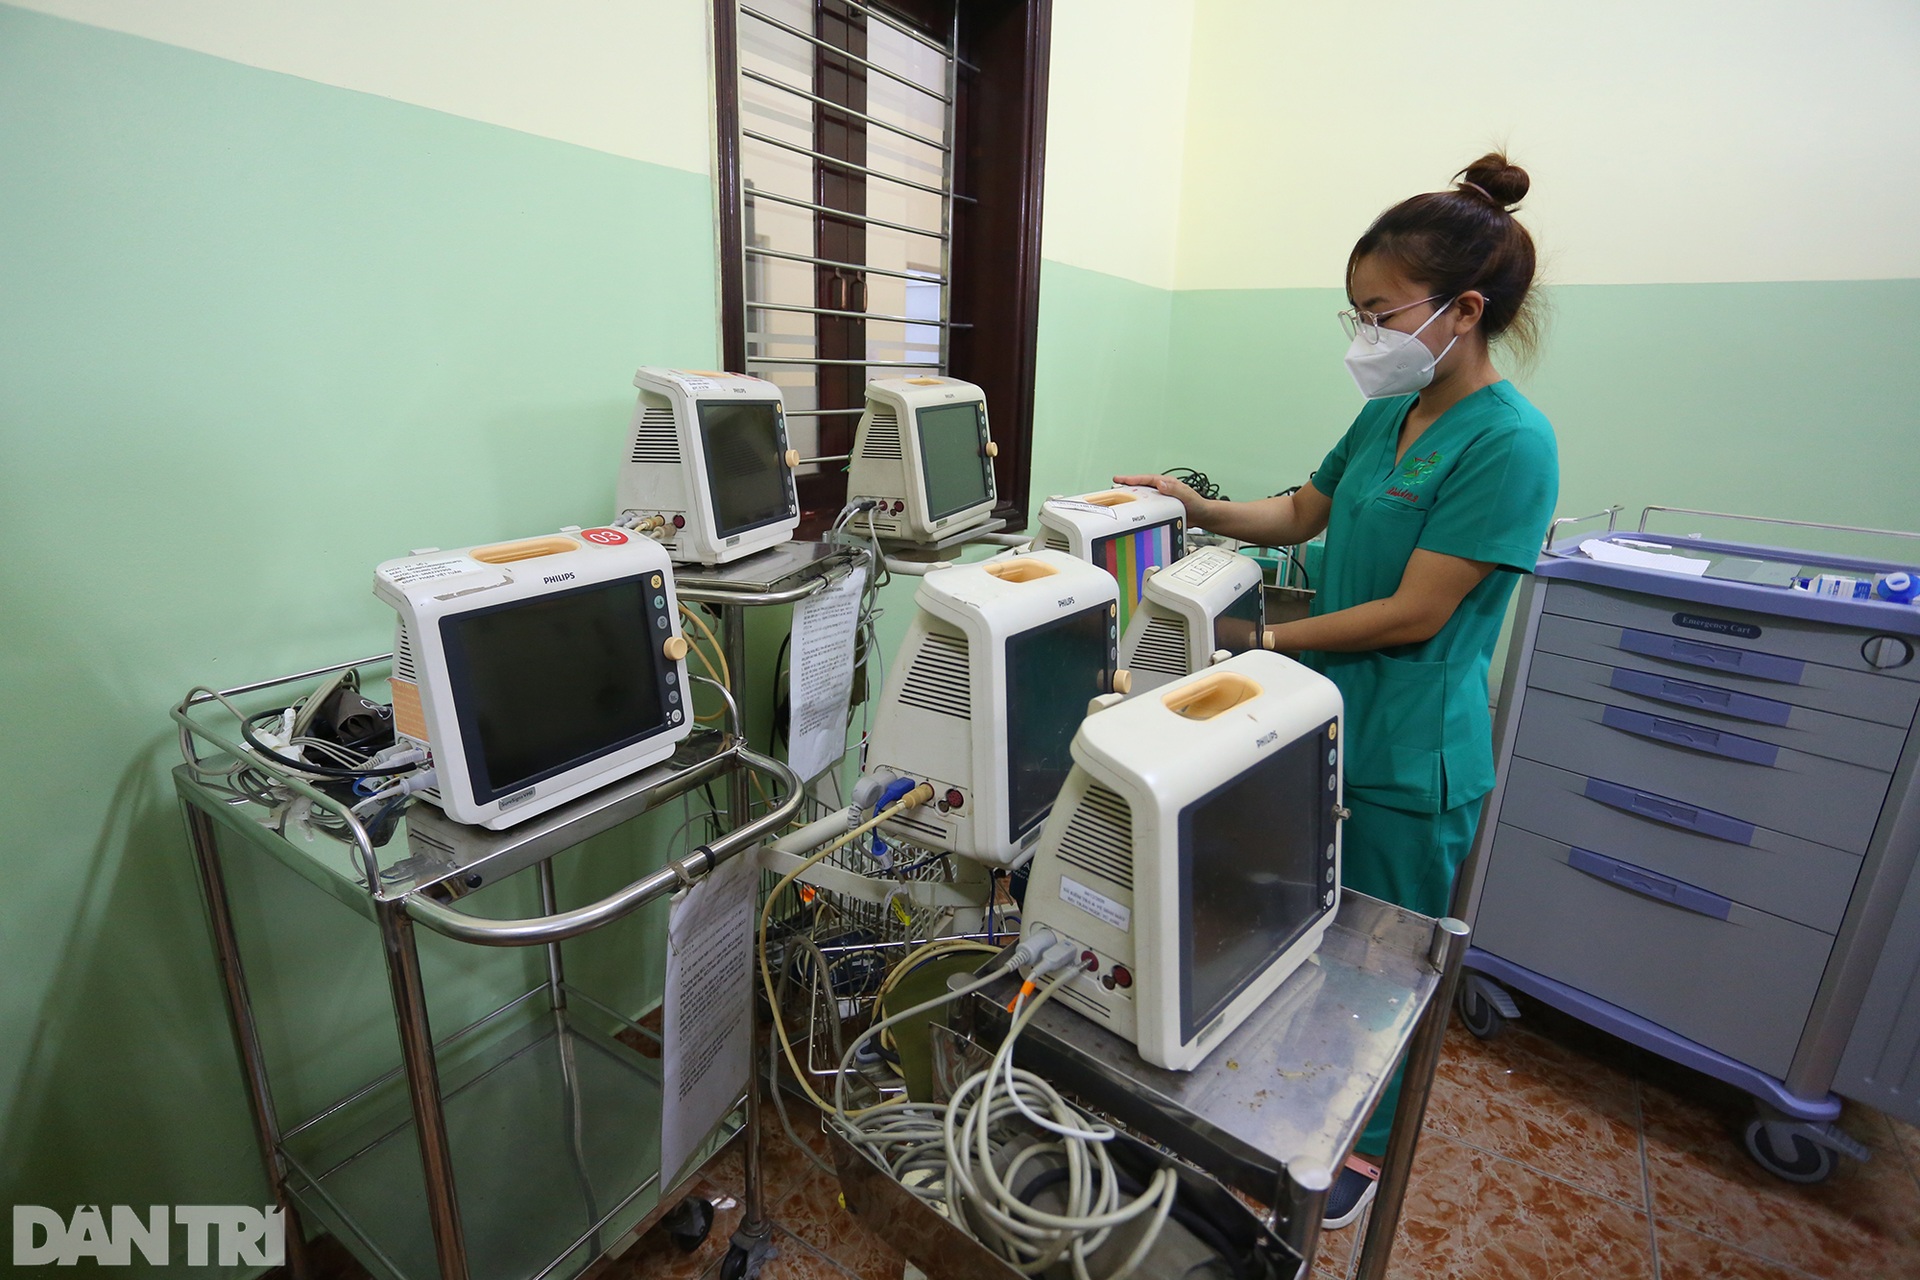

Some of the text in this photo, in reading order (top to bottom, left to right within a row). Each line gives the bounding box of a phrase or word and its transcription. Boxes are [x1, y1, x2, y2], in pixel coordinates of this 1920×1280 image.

[589, 531, 622, 543] 03
[543, 571, 575, 584] PHILIPS
[1058, 596, 1075, 607] PHILIPS
[1682, 616, 1751, 634] Emergency Cart
[1256, 730, 1278, 748] PHILIPS
